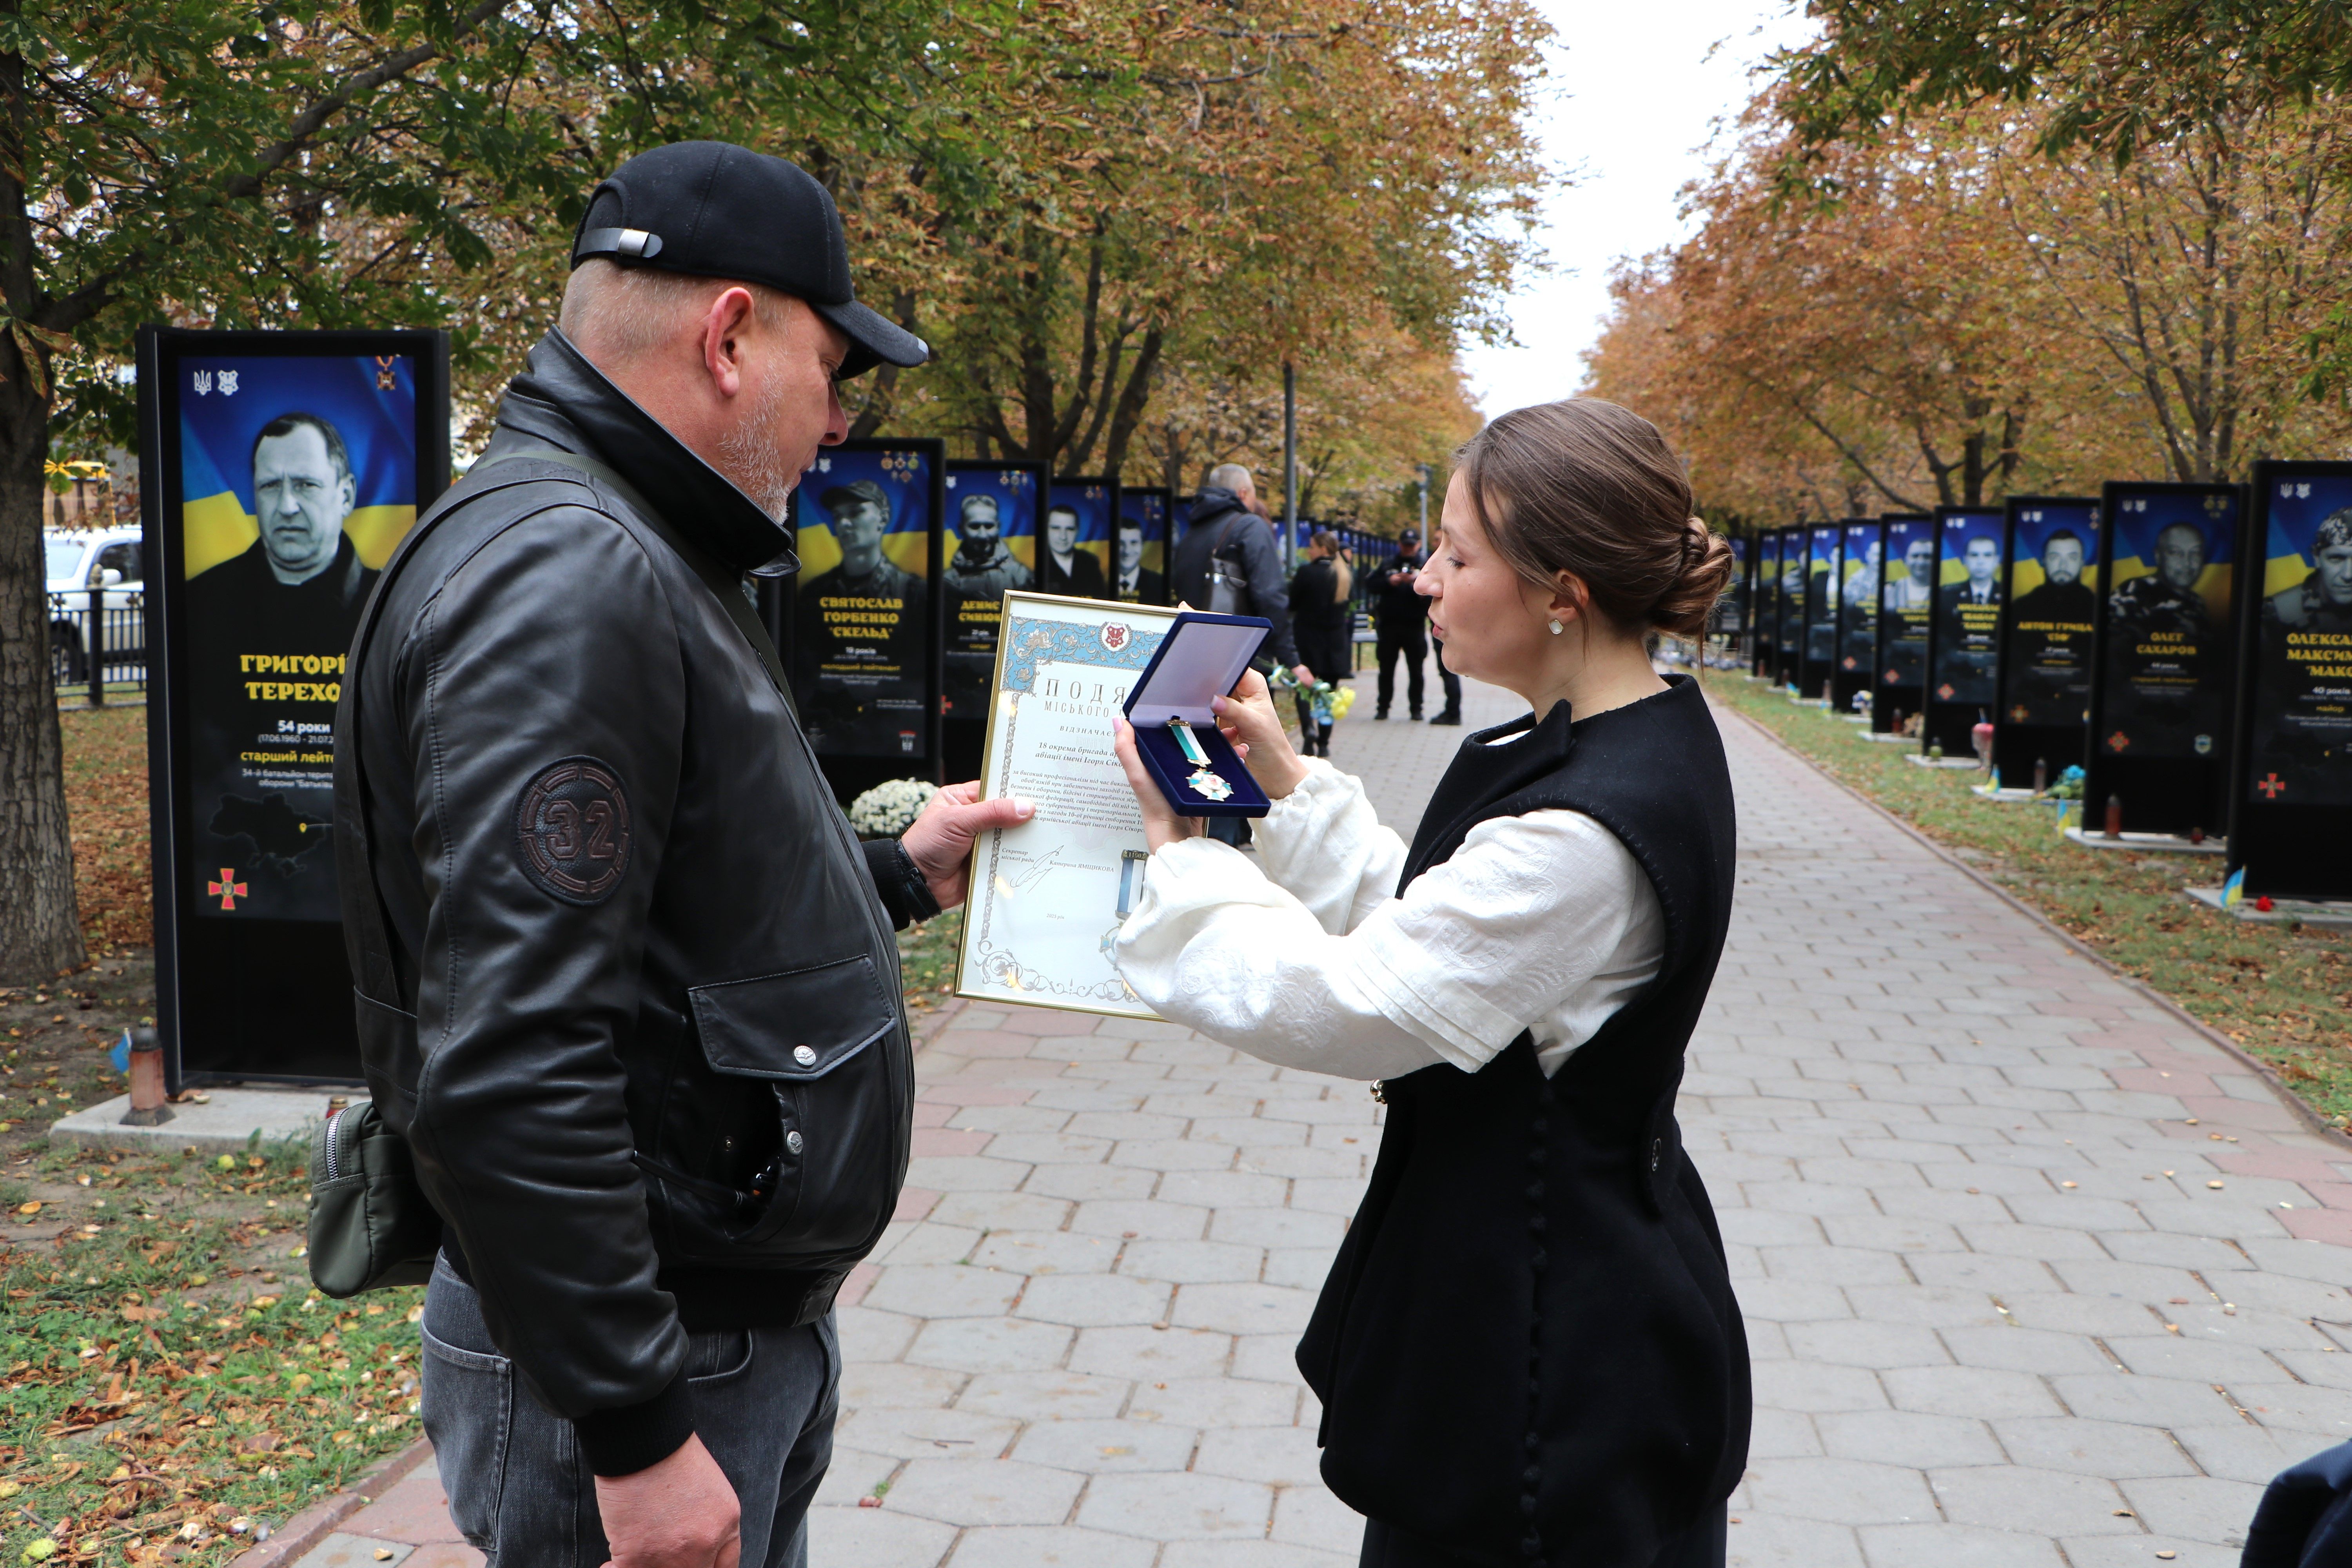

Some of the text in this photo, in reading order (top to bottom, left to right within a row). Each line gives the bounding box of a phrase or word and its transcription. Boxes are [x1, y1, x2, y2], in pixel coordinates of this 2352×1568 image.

[819, 597, 904, 609] СВЯТОСЛАВ
[961, 600, 1000, 611] ДЕНИС
[824, 611, 899, 624] ГОРБЕНКО
[2150, 632, 2184, 642] ОЛЕГ
[2287, 633, 2352, 645] ОЛЕКСА
[2136, 644, 2198, 655] САХАРОВ
[240, 653, 348, 675] ГРИГОРІ
[2305, 665, 2352, 677] "МАКС
[245, 682, 341, 702] ТЕРЕХО
[1045, 678, 1127, 705] ПОДЯ
[1044, 701, 1109, 717] МІСЬКОГО
[278, 720, 330, 734] 54 роки
[1060, 726, 1116, 737] ВІДЗНАЧАЄТ
[240, 750, 334, 764] старший лейт
[1049, 744, 1076, 753] окрема
[1078, 746, 1108, 757] бригада
[1035, 751, 1062, 761] авіації
[1083, 757, 1104, 766] Ігоря
[1106, 759, 1124, 769] Сіко
[1044, 773, 1088, 783] професіоналізм
[1045, 795, 1075, 804] федерації,
[1076, 799, 1110, 808] самовіддані
[1086, 793, 1125, 801] стримування
[1045, 802, 1085, 811] суверенітету
[1090, 808, 1138, 817] територіальної
[544, 800, 615, 859] 32
[1049, 860, 1114, 873] Катерина ЯМЩИКОВА
